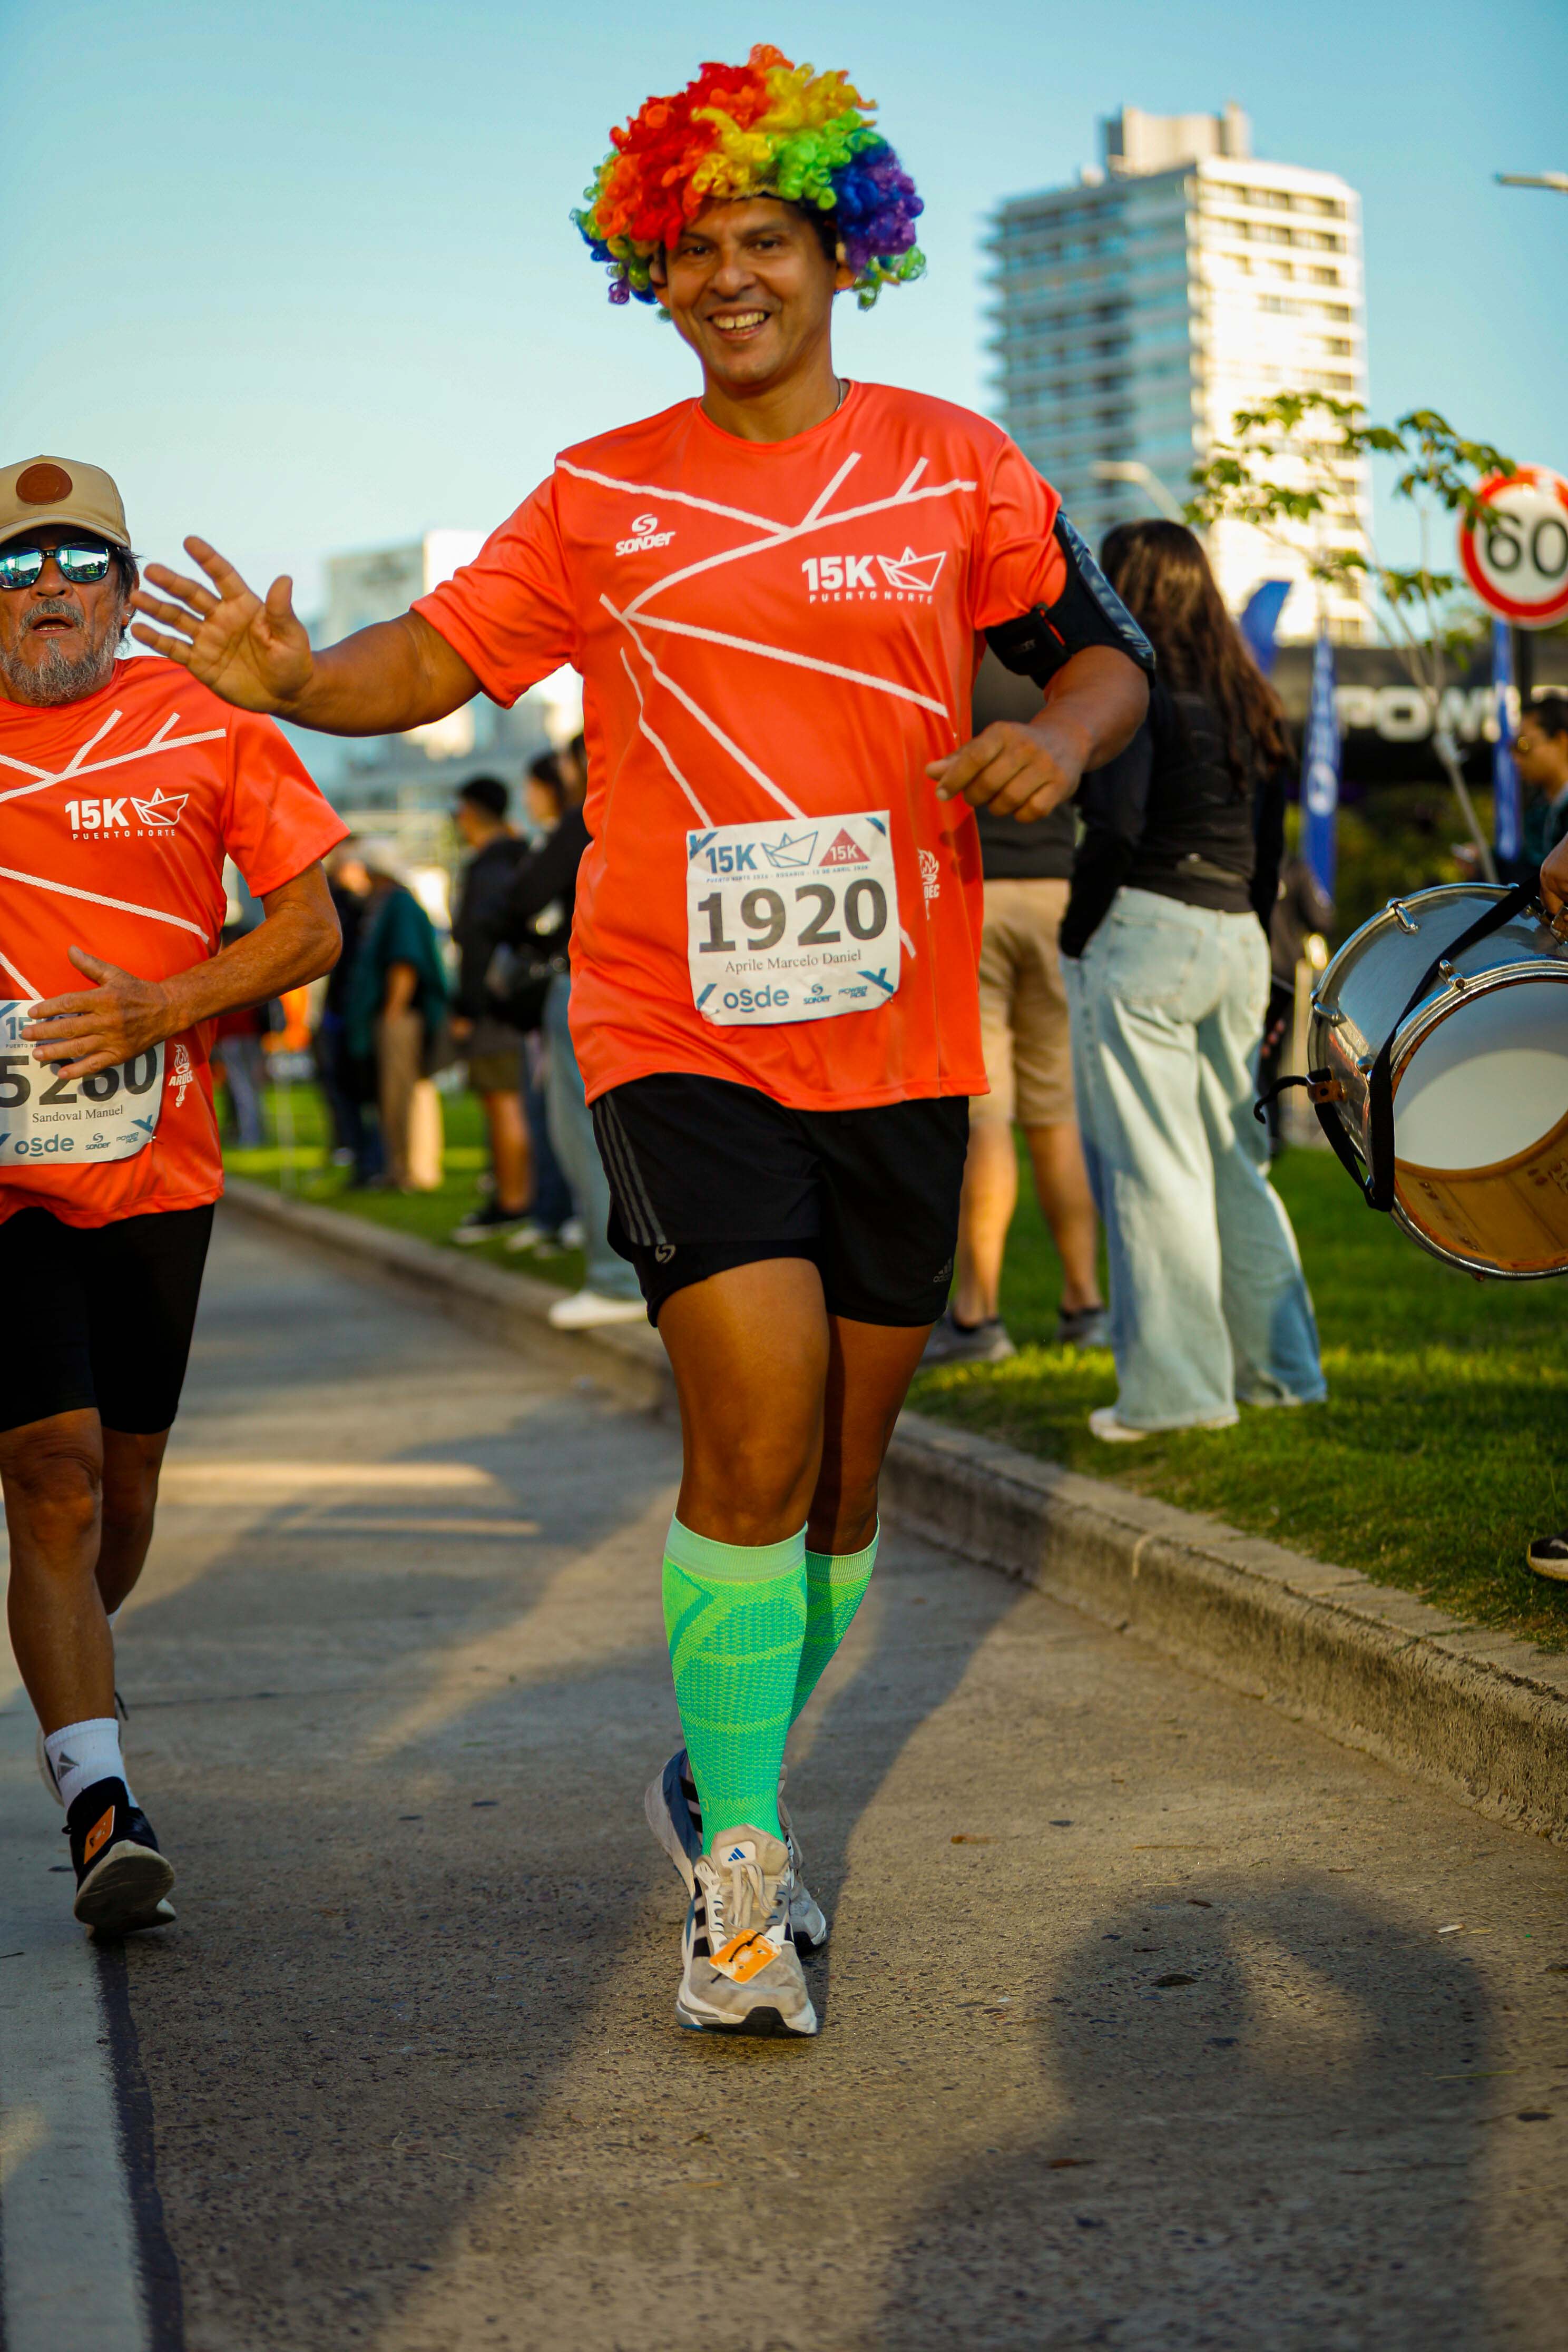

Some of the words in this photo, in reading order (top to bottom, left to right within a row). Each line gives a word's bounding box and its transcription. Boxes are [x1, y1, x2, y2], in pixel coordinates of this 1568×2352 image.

[1487, 510, 1568, 579] 60
[801, 555, 877, 591] 15K
[809, 591, 877, 604] PUERTO
[884, 591, 933, 605] NORTE
[65, 798, 130, 830] 15K
[73, 830, 130, 840] PUERTO
[705, 843, 758, 874] 15K
[830, 844, 859, 861] 15K
[698, 879, 887, 953] 1920
[725, 958, 763, 974] Aprile
[767, 955, 818, 969] Marcelo
[822, 949, 861, 964] Daniel
[723, 984, 789, 1012] osde
[0, 1046, 157, 1108] 5260
[32, 1111, 81, 1123] Sandoval
[85, 1105, 124, 1120] Manuel
[14, 1134, 74, 1157] osde
